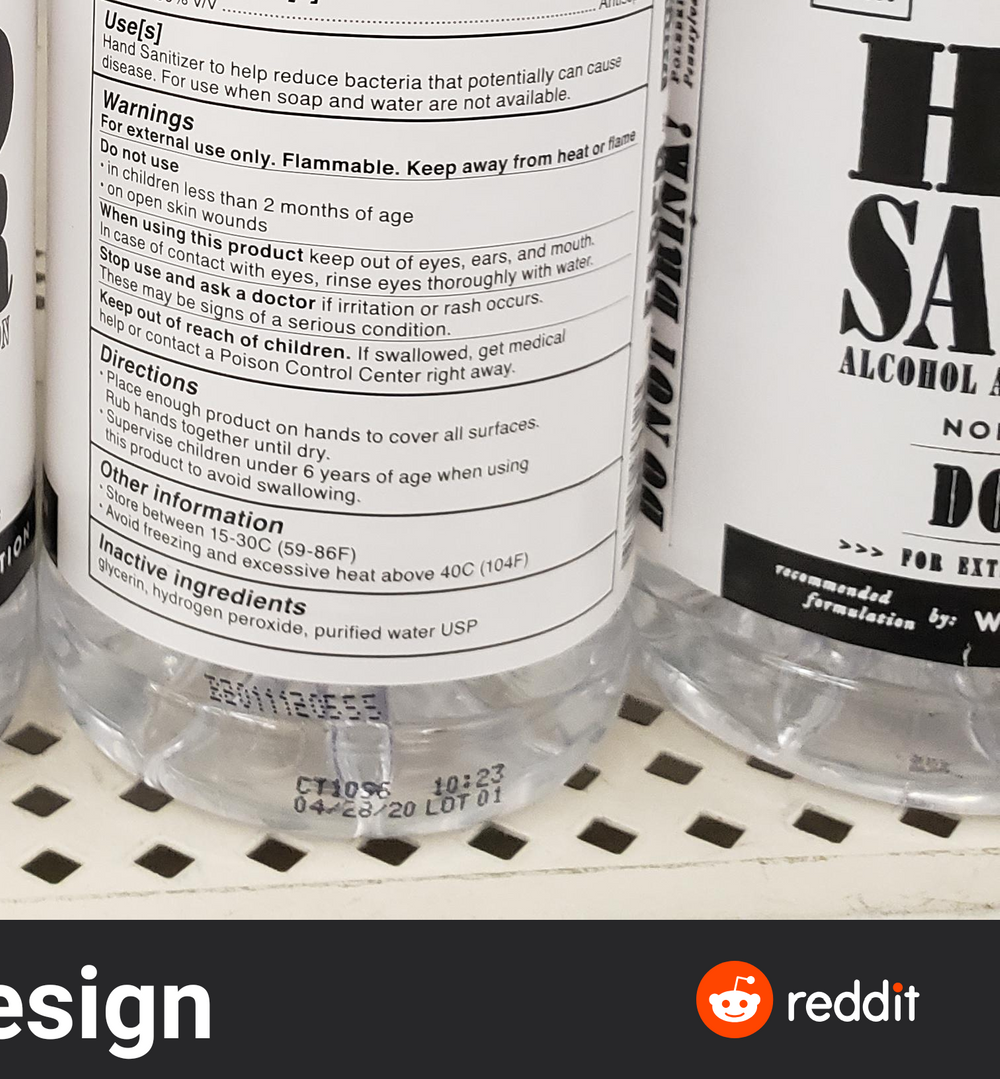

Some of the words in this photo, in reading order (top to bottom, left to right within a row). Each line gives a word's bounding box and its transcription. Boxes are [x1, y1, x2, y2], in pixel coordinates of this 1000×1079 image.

[105, 10, 163, 46] Use[s]
[103, 33, 136, 56] Hand
[140, 44, 205, 71] Sanitizer
[210, 60, 225, 75] to
[231, 61, 268, 82] help
[274, 70, 338, 87] reduce
[345, 72, 422, 90] bacteria
[428, 74, 463, 90] that
[468, 68, 554, 91] potentially
[558, 63, 583, 80] can
[587, 55, 622, 75] cause
[103, 89, 195, 132] Warnings
[100, 138, 118, 156] Do
[123, 145, 146, 165] not
[151, 156, 179, 173] use
[101, 113, 122, 133] For
[127, 124, 189, 150] external
[195, 141, 226, 158] use
[230, 149, 276, 169] only.
[282, 152, 400, 176] Flammable.
[407, 160, 457, 179] Keep
[462, 157, 508, 176] away
[513, 153, 552, 169] from
[557, 144, 589, 164] heat
[592, 141, 605, 156] or
[607, 129, 636, 150] flame
[100, 289, 133, 315] Keep
[138, 306, 161, 325] out
[166, 316, 181, 330] of
[186, 322, 234, 344] reach
[240, 335, 259, 349] of
[264, 338, 351, 360] children.
[358, 346, 369, 361] If
[375, 346, 473, 363] swallowed,
[479, 343, 504, 361] get
[508, 328, 566, 353] medical
[100, 344, 199, 395] Directions
[838, 345, 977, 395] ALCOHOL
[107, 370, 142, 396] Place
[146, 389, 201, 417] enough
[206, 408, 270, 432] product
[276, 422, 298, 436] on
[305, 423, 360, 442] hands
[367, 429, 383, 444] to
[389, 431, 439, 444] cover
[444, 426, 463, 442] all
[468, 417, 540, 440] surfaces.
[101, 460, 148, 496] Other
[153, 484, 284, 535] information
[106, 484, 139, 512] Store
[143, 502, 204, 537] between
[211, 527, 271, 553] 15-30C
[278, 539, 357, 565] (59-86F)
[100, 533, 168, 581] Inactive
[174, 569, 307, 616] ingredients
[775, 564, 893, 605] recommended
[901, 547, 943, 572] FOR
[98, 556, 148, 595] glycerin,
[152, 580, 223, 619] hydrogen
[229, 609, 308, 637] peroxide,
[314, 624, 382, 640] purified
[387, 626, 436, 640] water
[441, 619, 478, 637] USP
[802, 592, 916, 631] formulation
[929, 608, 958, 630] by:
[426, 793, 470, 816] LOT
[478, 785, 502, 807] 01
[434, 763, 505, 796] 10:23
